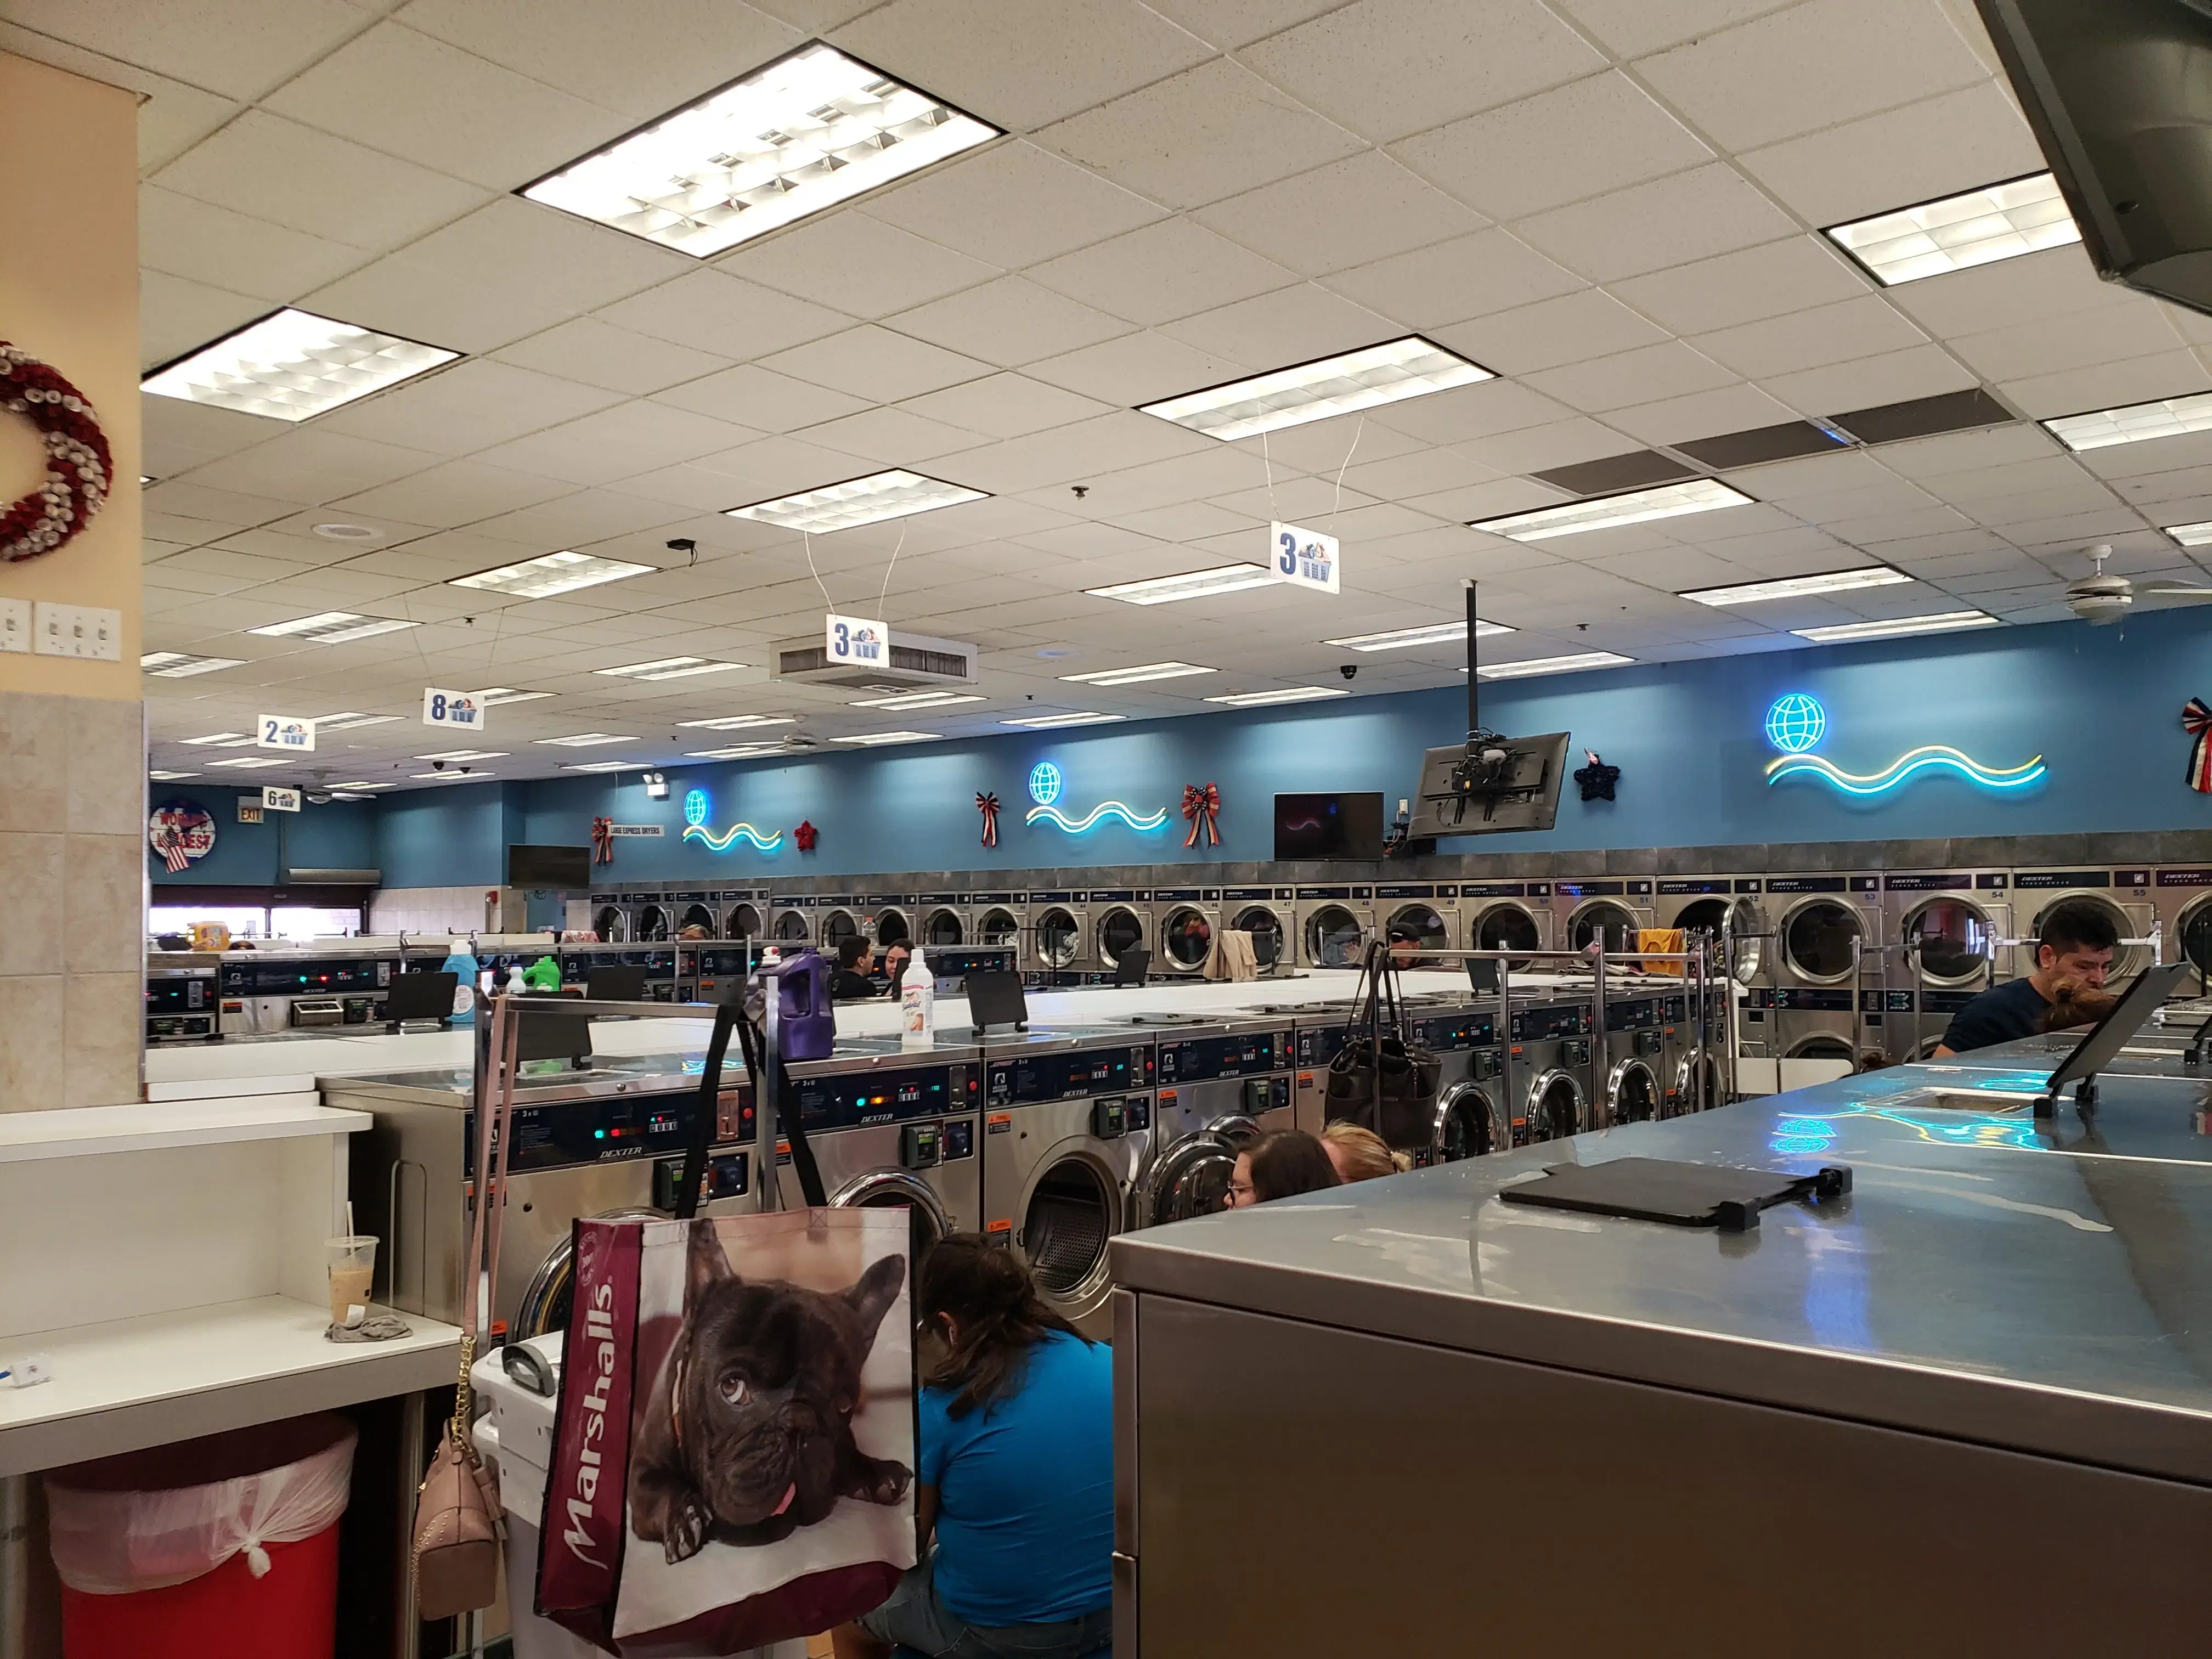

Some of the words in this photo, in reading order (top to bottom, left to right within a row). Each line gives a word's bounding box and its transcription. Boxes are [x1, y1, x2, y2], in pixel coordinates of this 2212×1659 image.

[1279, 532, 1296, 575] 3
[834, 623, 849, 657] 3
[431, 694, 446, 720] 8
[265, 720, 278, 743] 2
[268, 791, 277, 806] 6
[241, 808, 261, 821] EXIT
[1062, 1088, 1088, 1098] DEXTER
[860, 1113, 894, 1124] DEXTER
[599, 1146, 642, 1159] DEXTER
[563, 1283, 616, 1571] Marshalls
